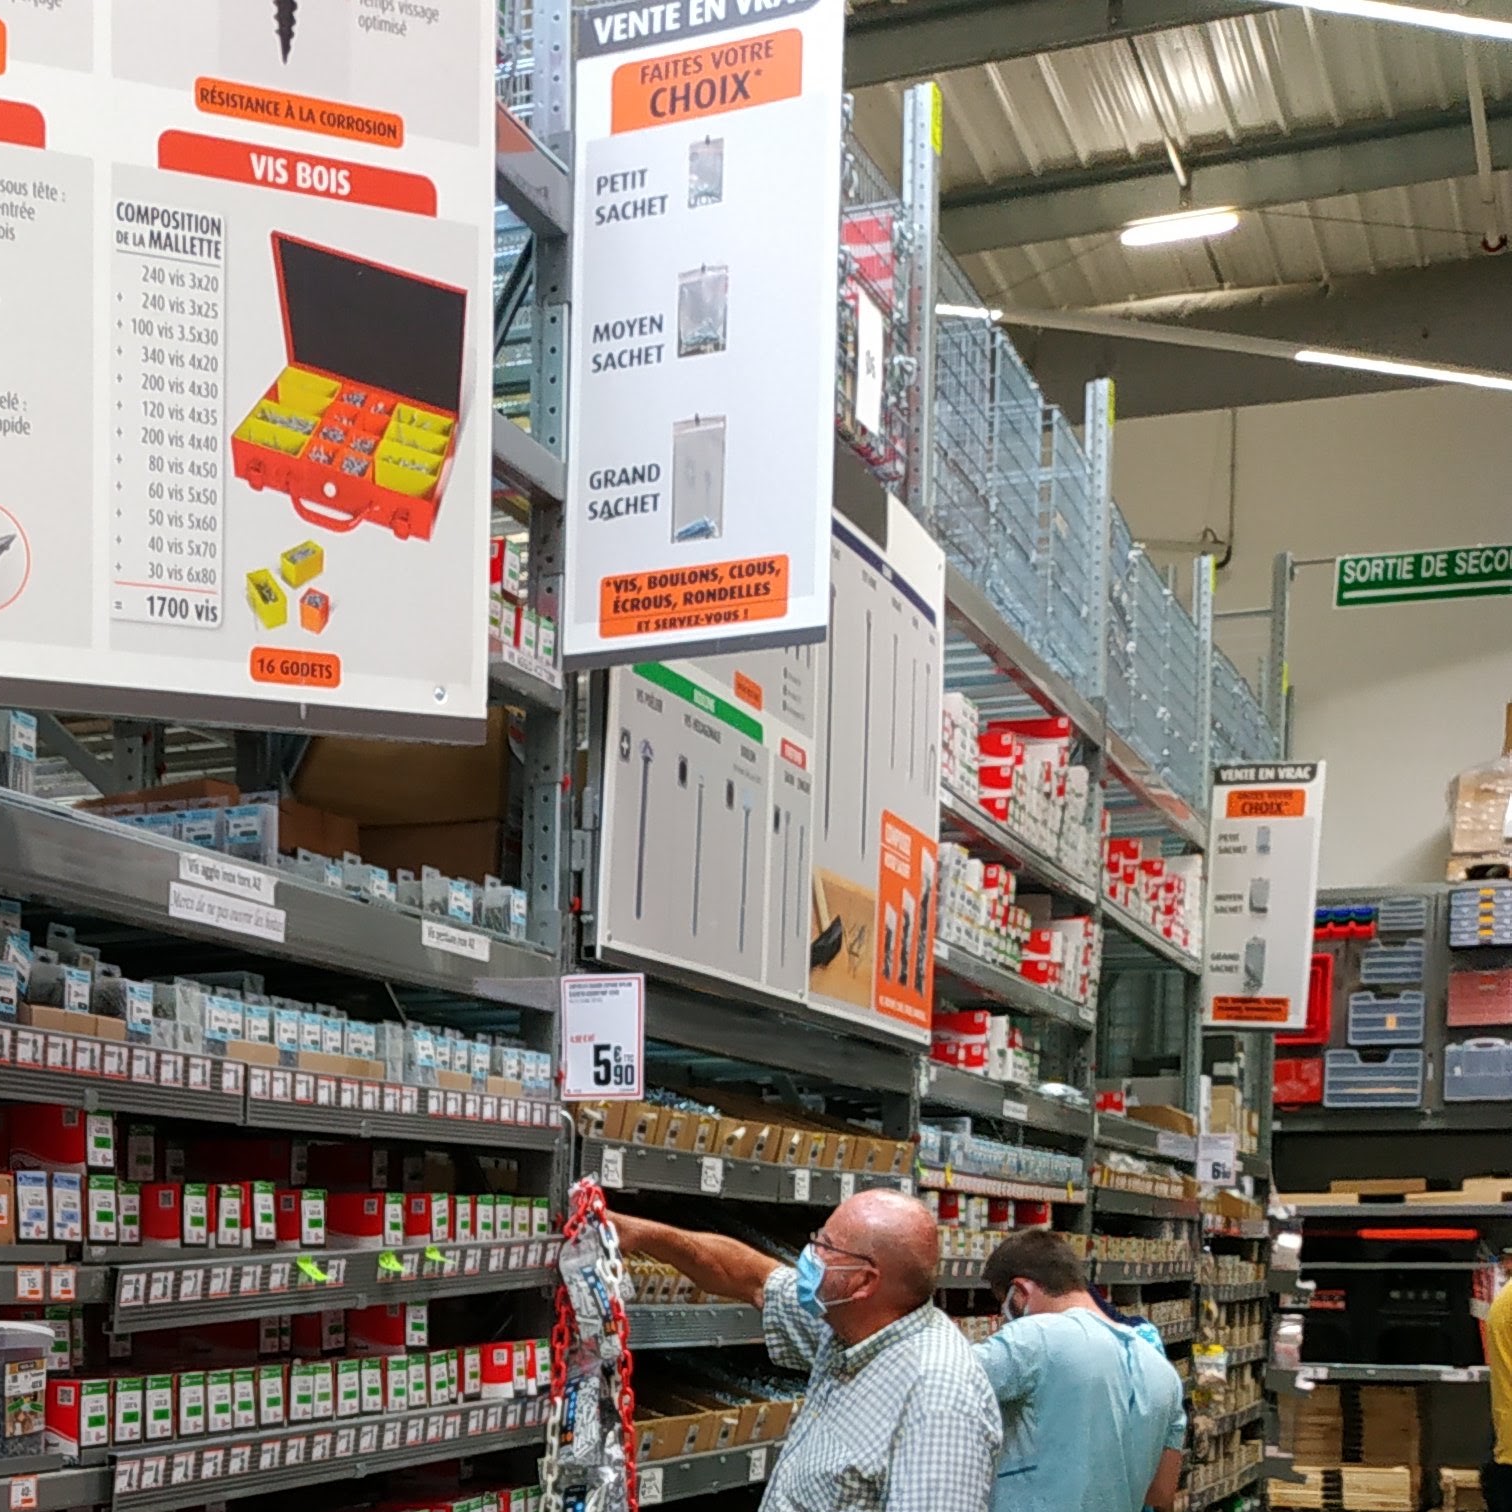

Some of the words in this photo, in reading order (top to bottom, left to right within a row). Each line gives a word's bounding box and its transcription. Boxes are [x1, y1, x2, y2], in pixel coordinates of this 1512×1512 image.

[594, 3, 681, 45] VENTE
[689, 0, 726, 26] EN
[640, 54, 703, 85] FAITES
[711, 39, 774, 70] VOTRE
[200, 84, 280, 118] RÉSISTANCE
[299, 107, 315, 124] LA
[320, 110, 397, 139] CORROSION
[250, 152, 288, 184] VIS
[296, 160, 351, 196] BOIS
[596, 168, 648, 195] PETIT
[0, 178, 28, 197] sous
[32, 182, 58, 202] tête
[116, 200, 222, 239] COMPOSITION
[595, 195, 669, 226] SACHET
[116, 230, 130, 245] DE
[133, 232, 146, 248] LA
[149, 229, 222, 260] MALLETTE
[142, 265, 165, 284] 240
[169, 269, 185, 287] vis
[189, 274, 219, 293] 3x20
[142, 292, 165, 311] 240
[169, 296, 185, 314] vis
[189, 301, 219, 320] 3x25
[131, 318, 153, 337] 100
[158, 323, 174, 340] vis
[178, 325, 219, 346] 3.5x30
[593, 314, 663, 344] MOYEN
[142, 346, 165, 365] 340
[169, 350, 185, 368] vis
[189, 355, 218, 373] 4x20
[592, 345, 665, 373] SACHET
[142, 400, 164, 419] 120
[168, 404, 185, 422] vis
[188, 408, 217, 426] 4x35
[148, 455, 164, 472] 80
[168, 458, 184, 475] vis
[188, 461, 217, 479] 4x50
[590, 463, 661, 490] GRAND
[148, 482, 164, 499] 60
[168, 485, 184, 502] vis
[188, 487, 217, 505] 5x50
[588, 494, 661, 521] SACHET
[148, 536, 164, 553] 40
[167, 538, 183, 555] vis
[188, 541, 217, 559] 5x70
[148, 562, 164, 579] 30
[167, 565, 183, 582] vis
[188, 567, 216, 585] 6x80
[647, 568, 724, 590] BOULONS,
[729, 561, 781, 579] CLOUS,
[1343, 557, 1414, 584] SORTIE
[1421, 554, 1447, 577] DE
[1454, 548, 1512, 575] SECO
[147, 596, 189, 619] 1700
[195, 601, 218, 622] vis
[613, 594, 678, 614] ÉCROUS,
[683, 582, 770, 606] RONDELLES
[638, 621, 650, 632] ET
[655, 611, 738, 632] SERVEZ-VOUS
[258, 659, 275, 674] 16
[280, 660, 333, 679] GODETS
[1258, 767, 1275, 780] EN
[593, 1044, 611, 1086] 5
[614, 1064, 634, 1086] 90
